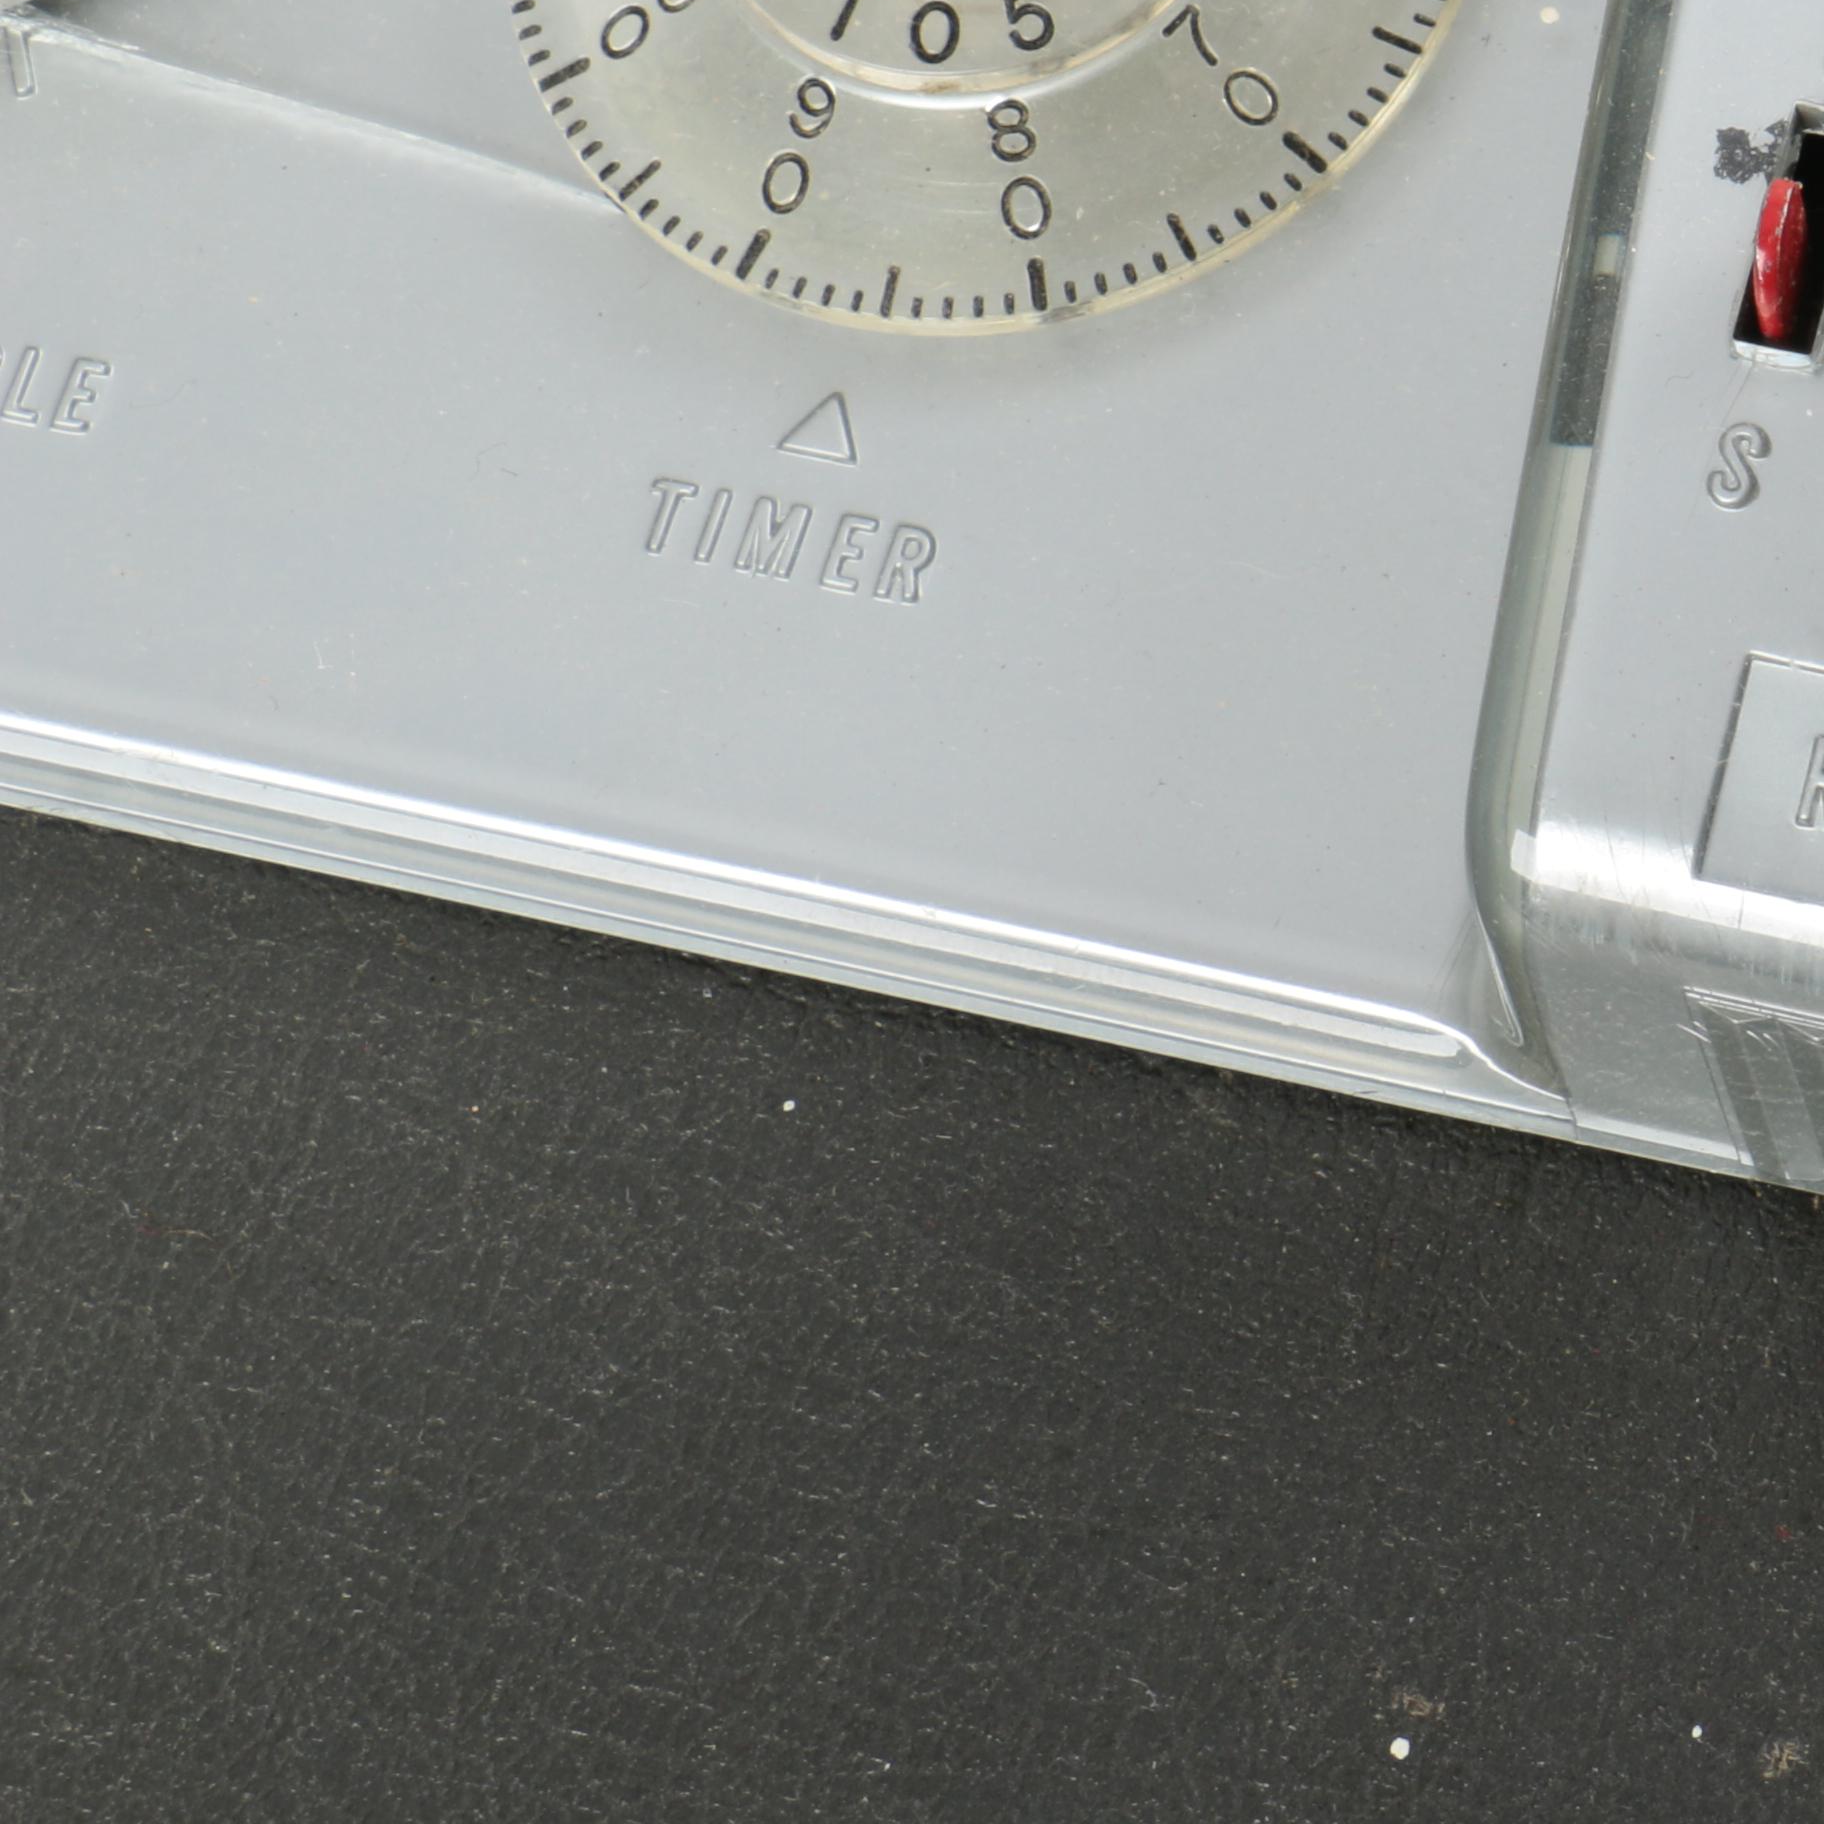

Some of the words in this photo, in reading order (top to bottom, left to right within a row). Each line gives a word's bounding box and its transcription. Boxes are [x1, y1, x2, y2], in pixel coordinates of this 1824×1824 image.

[909, 0, 960, 64] 0
[0, 344, 114, 436] LE
[1706, 421, 1772, 511] S
[646, 478, 937, 604] TIMER
